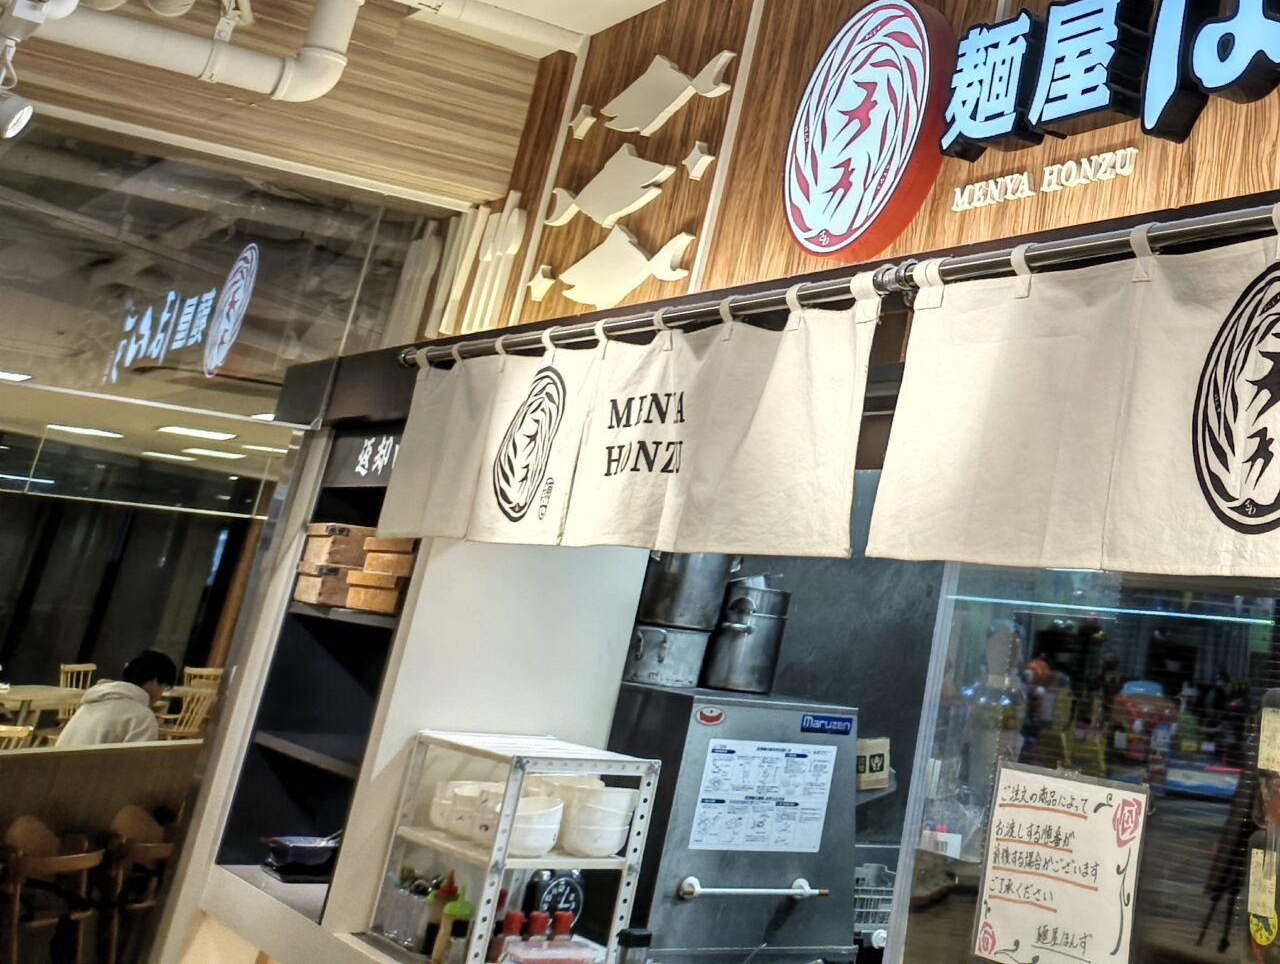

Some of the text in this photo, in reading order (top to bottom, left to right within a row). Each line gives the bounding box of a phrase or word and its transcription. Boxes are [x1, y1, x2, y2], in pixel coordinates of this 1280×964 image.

[952, 147, 1139, 212] MENYA HONZU
[803, 715, 851, 732] Maruzen
[1001, 784, 1089, 814] ご注文の商品によって
[990, 877, 1054, 902] ご了承ください
